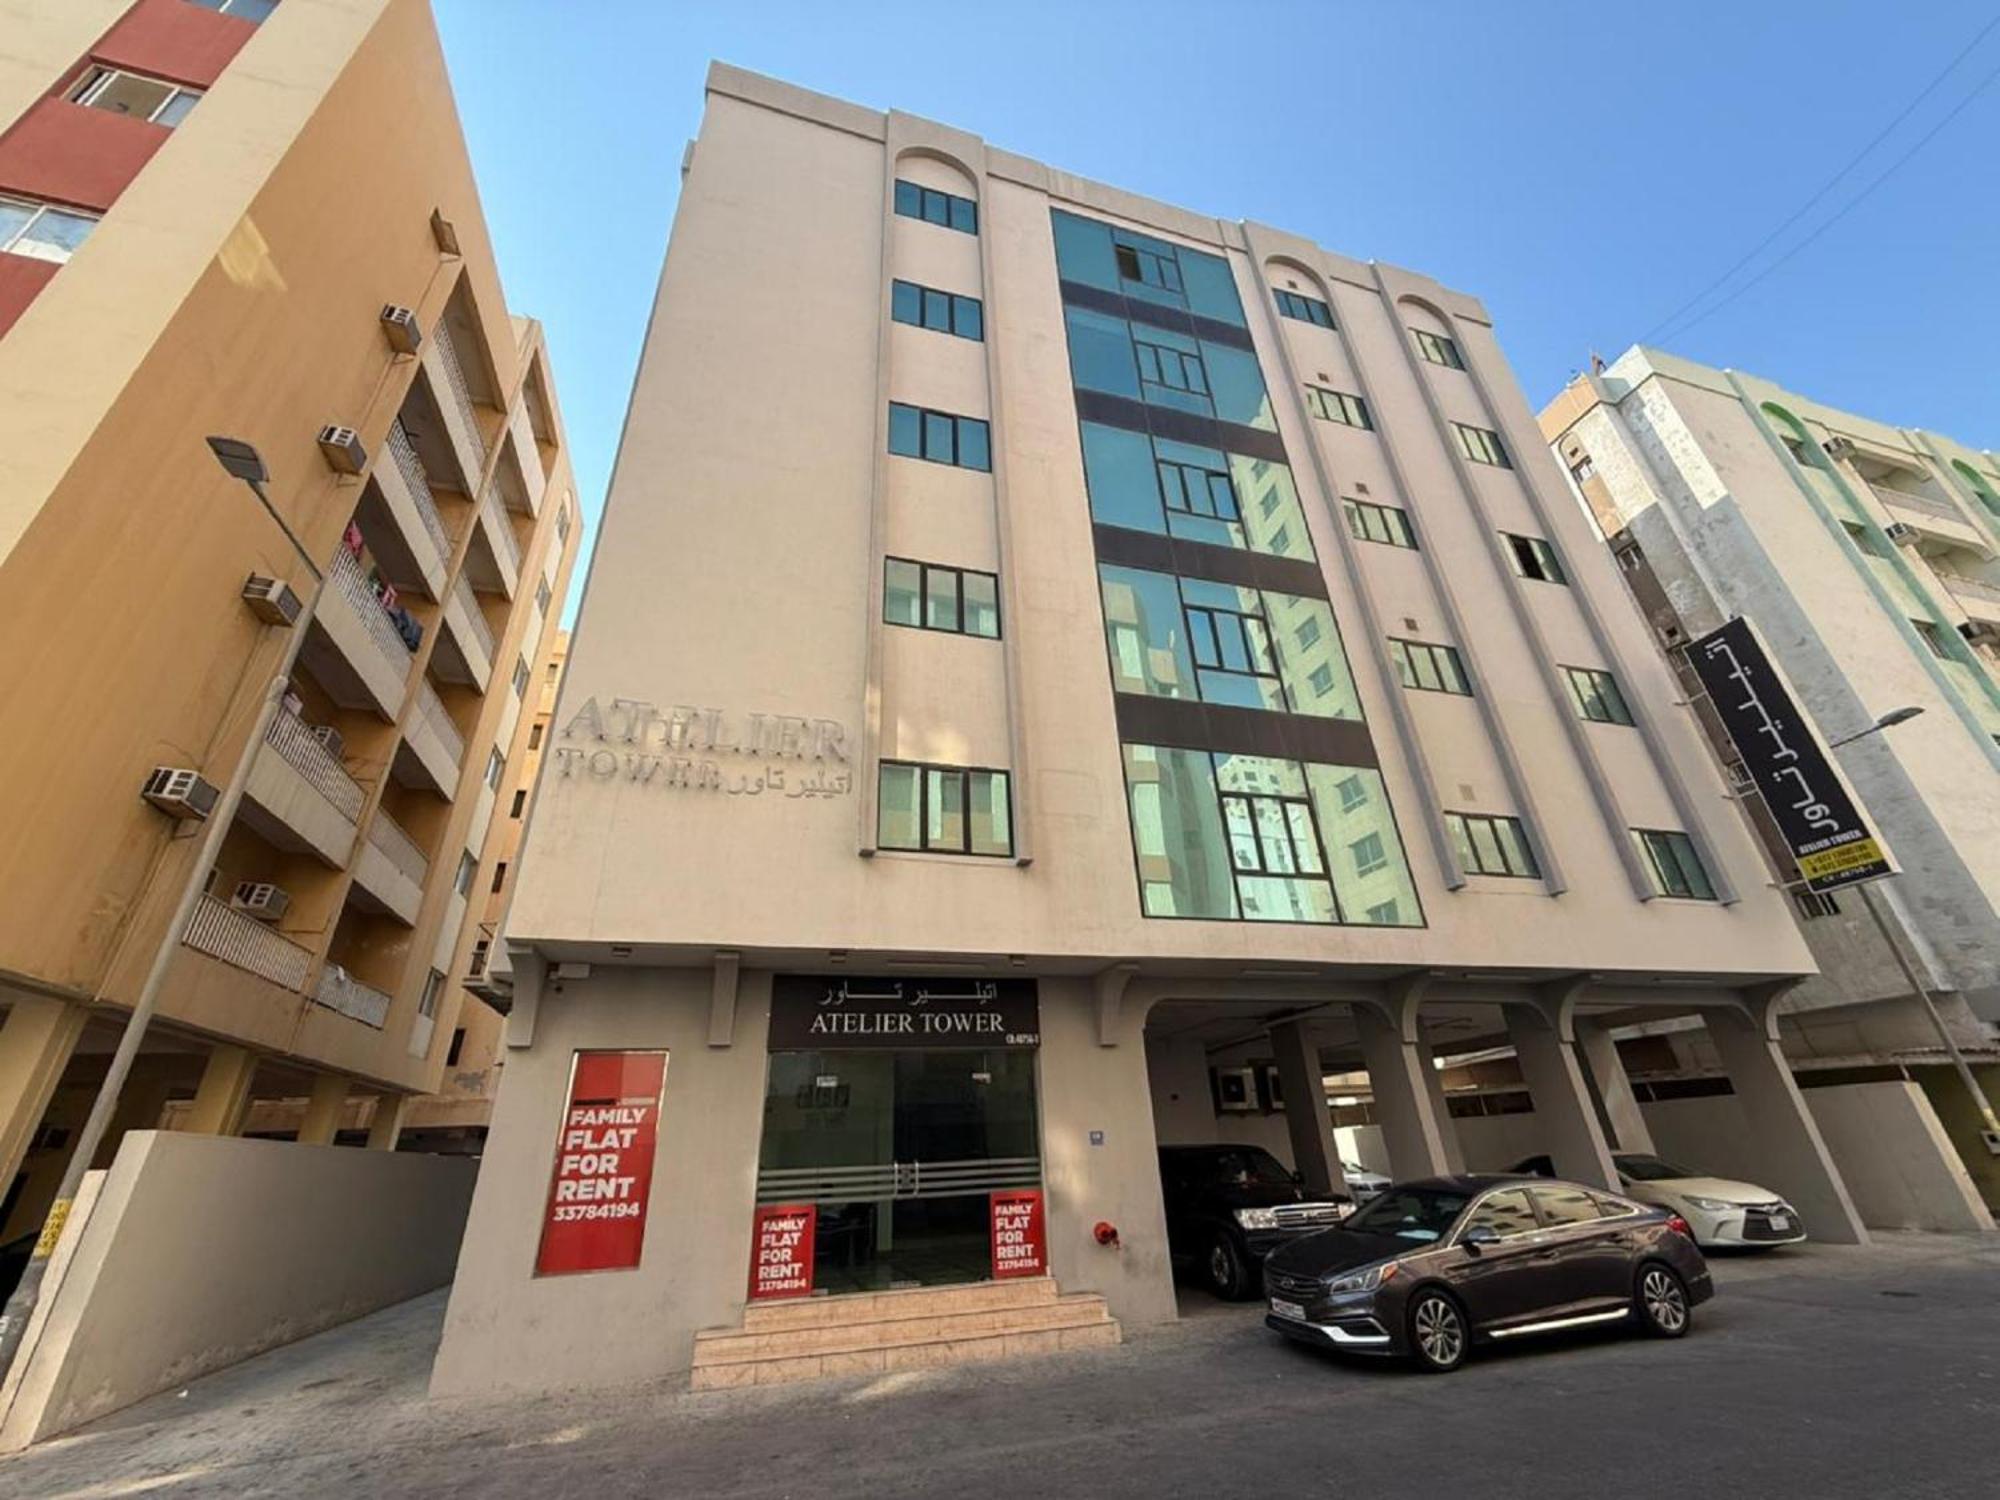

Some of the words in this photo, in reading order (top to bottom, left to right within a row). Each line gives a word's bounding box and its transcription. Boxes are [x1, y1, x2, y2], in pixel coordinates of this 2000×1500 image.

[556, 748, 720, 790] TOWER
[728, 766, 785, 795] تاور
[810, 1013, 912, 1033] ATELIER
[919, 1013, 1004, 1032] TOWER
[569, 1108, 646, 1126] FAMILY
[565, 1129, 637, 1150] FLAT
[561, 1154, 619, 1175] FOR
[556, 1178, 635, 1202] RENT
[553, 1202, 640, 1221] 33784194
[995, 1203, 1032, 1216] FAMILY
[762, 1218, 806, 1232] FAMILY
[995, 1216, 1030, 1230] FLAT
[761, 1232, 803, 1248] FLAT
[996, 1230, 1023, 1244] FOR
[760, 1247, 792, 1264] FOR
[997, 1243, 1034, 1259] RENT
[758, 1262, 804, 1279] RENT
